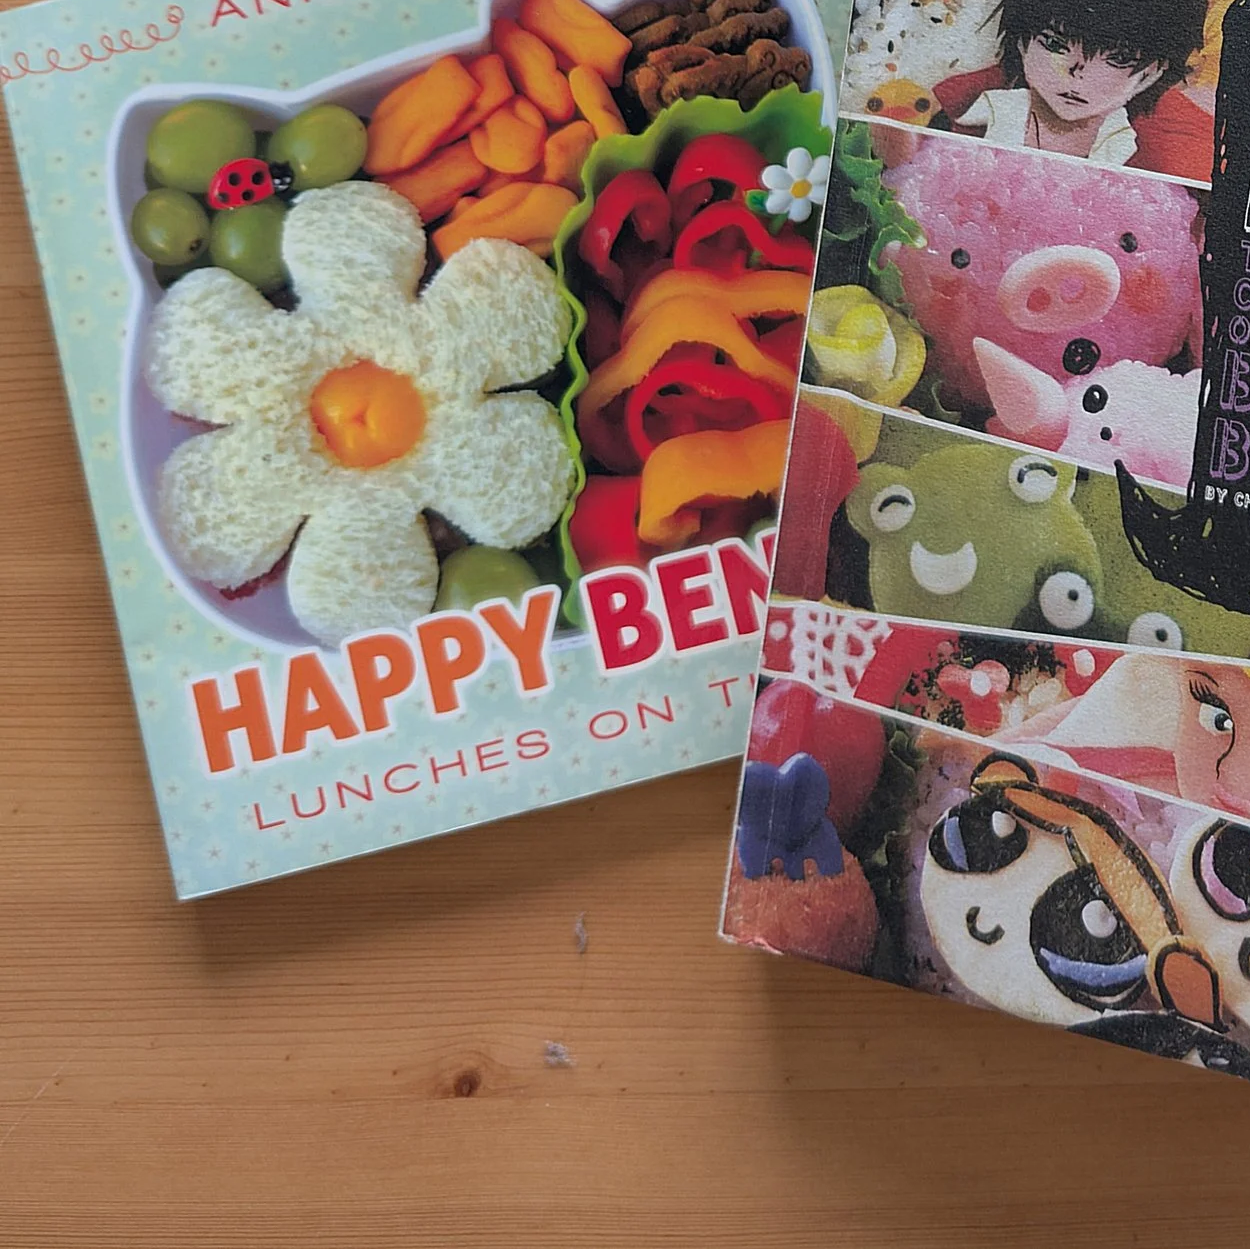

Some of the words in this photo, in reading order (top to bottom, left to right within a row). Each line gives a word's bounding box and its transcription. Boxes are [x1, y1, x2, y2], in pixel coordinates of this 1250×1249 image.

[1204, 485, 1228, 503] BY
[192, 591, 556, 773] HAPPY
[254, 729, 551, 830] LUNCHES
[588, 694, 674, 740] ON
[708, 672, 756, 708] T
